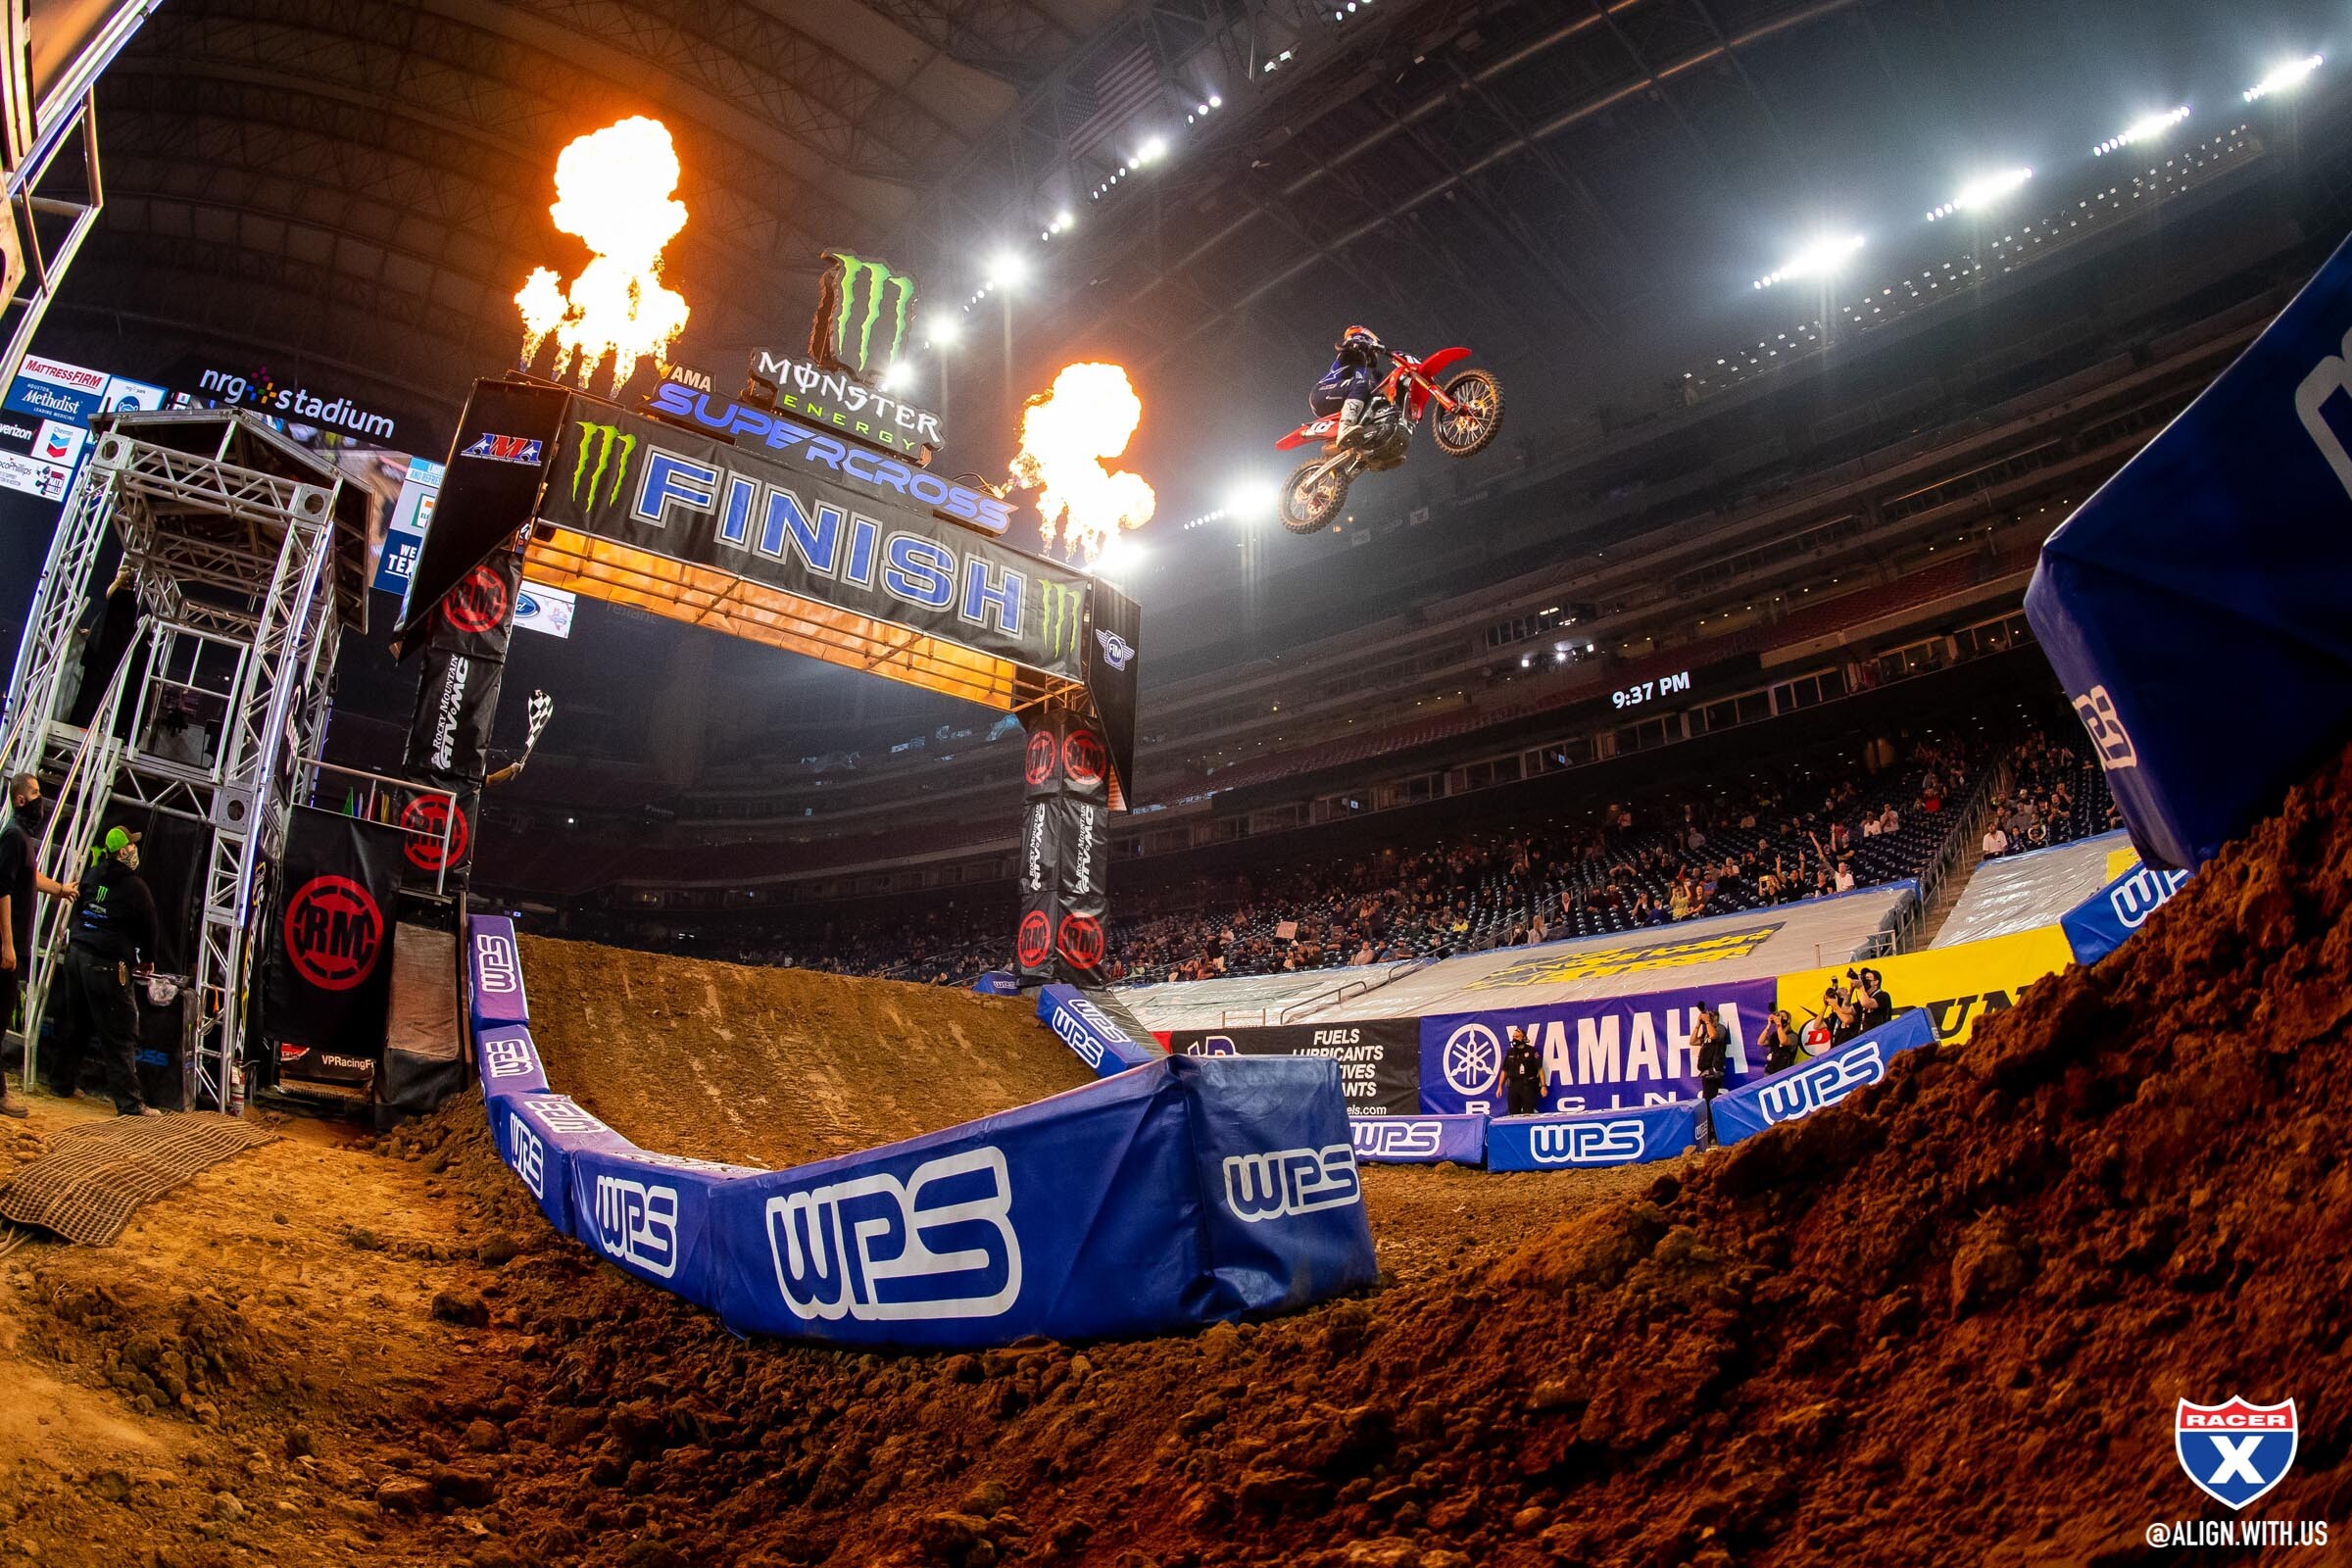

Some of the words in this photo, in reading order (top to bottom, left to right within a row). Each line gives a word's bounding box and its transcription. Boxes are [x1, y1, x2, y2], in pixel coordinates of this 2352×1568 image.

[26, 383, 50, 392] HOUSTON
[670, 366, 712, 392] AMA
[22, 389, 80, 415] Methodist
[33, 407, 53, 416] LEADING
[53, 412, 75, 422] MEDICINE
[201, 368, 246, 403] nrg
[274, 387, 394, 439] stadium
[783, 394, 916, 451] ENERGY
[0, 422, 32, 441] verizon
[53, 425, 74, 437] Chevron
[460, 432, 543, 463] AMA
[650, 381, 1019, 531] SUPERCROSS
[400, 544, 417, 559] WE
[629, 443, 1027, 641] FINISH
[1108, 643, 1122, 660] FIM
[439, 654, 460, 714] MOUNTAIN
[1612, 682, 1653, 709] 9:37
[1659, 671, 1690, 697] PM
[432, 712, 447, 751] ROCKY
[2072, 685, 2136, 772] PS
[1077, 804, 1087, 850] MOUNTAIN
[477, 934, 516, 994] WPS
[1052, 1005, 1104, 1069] WPS
[1067, 999, 1132, 1043] WPS
[1313, 1028, 1360, 1046] FUELS
[486, 1039, 534, 1078] WPS
[1465, 1088, 1731, 1115] RCIN
[1756, 1041, 1885, 1126] WPS
[523, 1100, 609, 1134] WPS
[510, 1112, 544, 1200] WPS
[1350, 1121, 1443, 1157] WPS
[1529, 1119, 1646, 1164] WPS
[1222, 1143, 1362, 1224] WPS
[596, 1174, 678, 1279] WPS
[766, 1145, 1023, 1321] WPS
